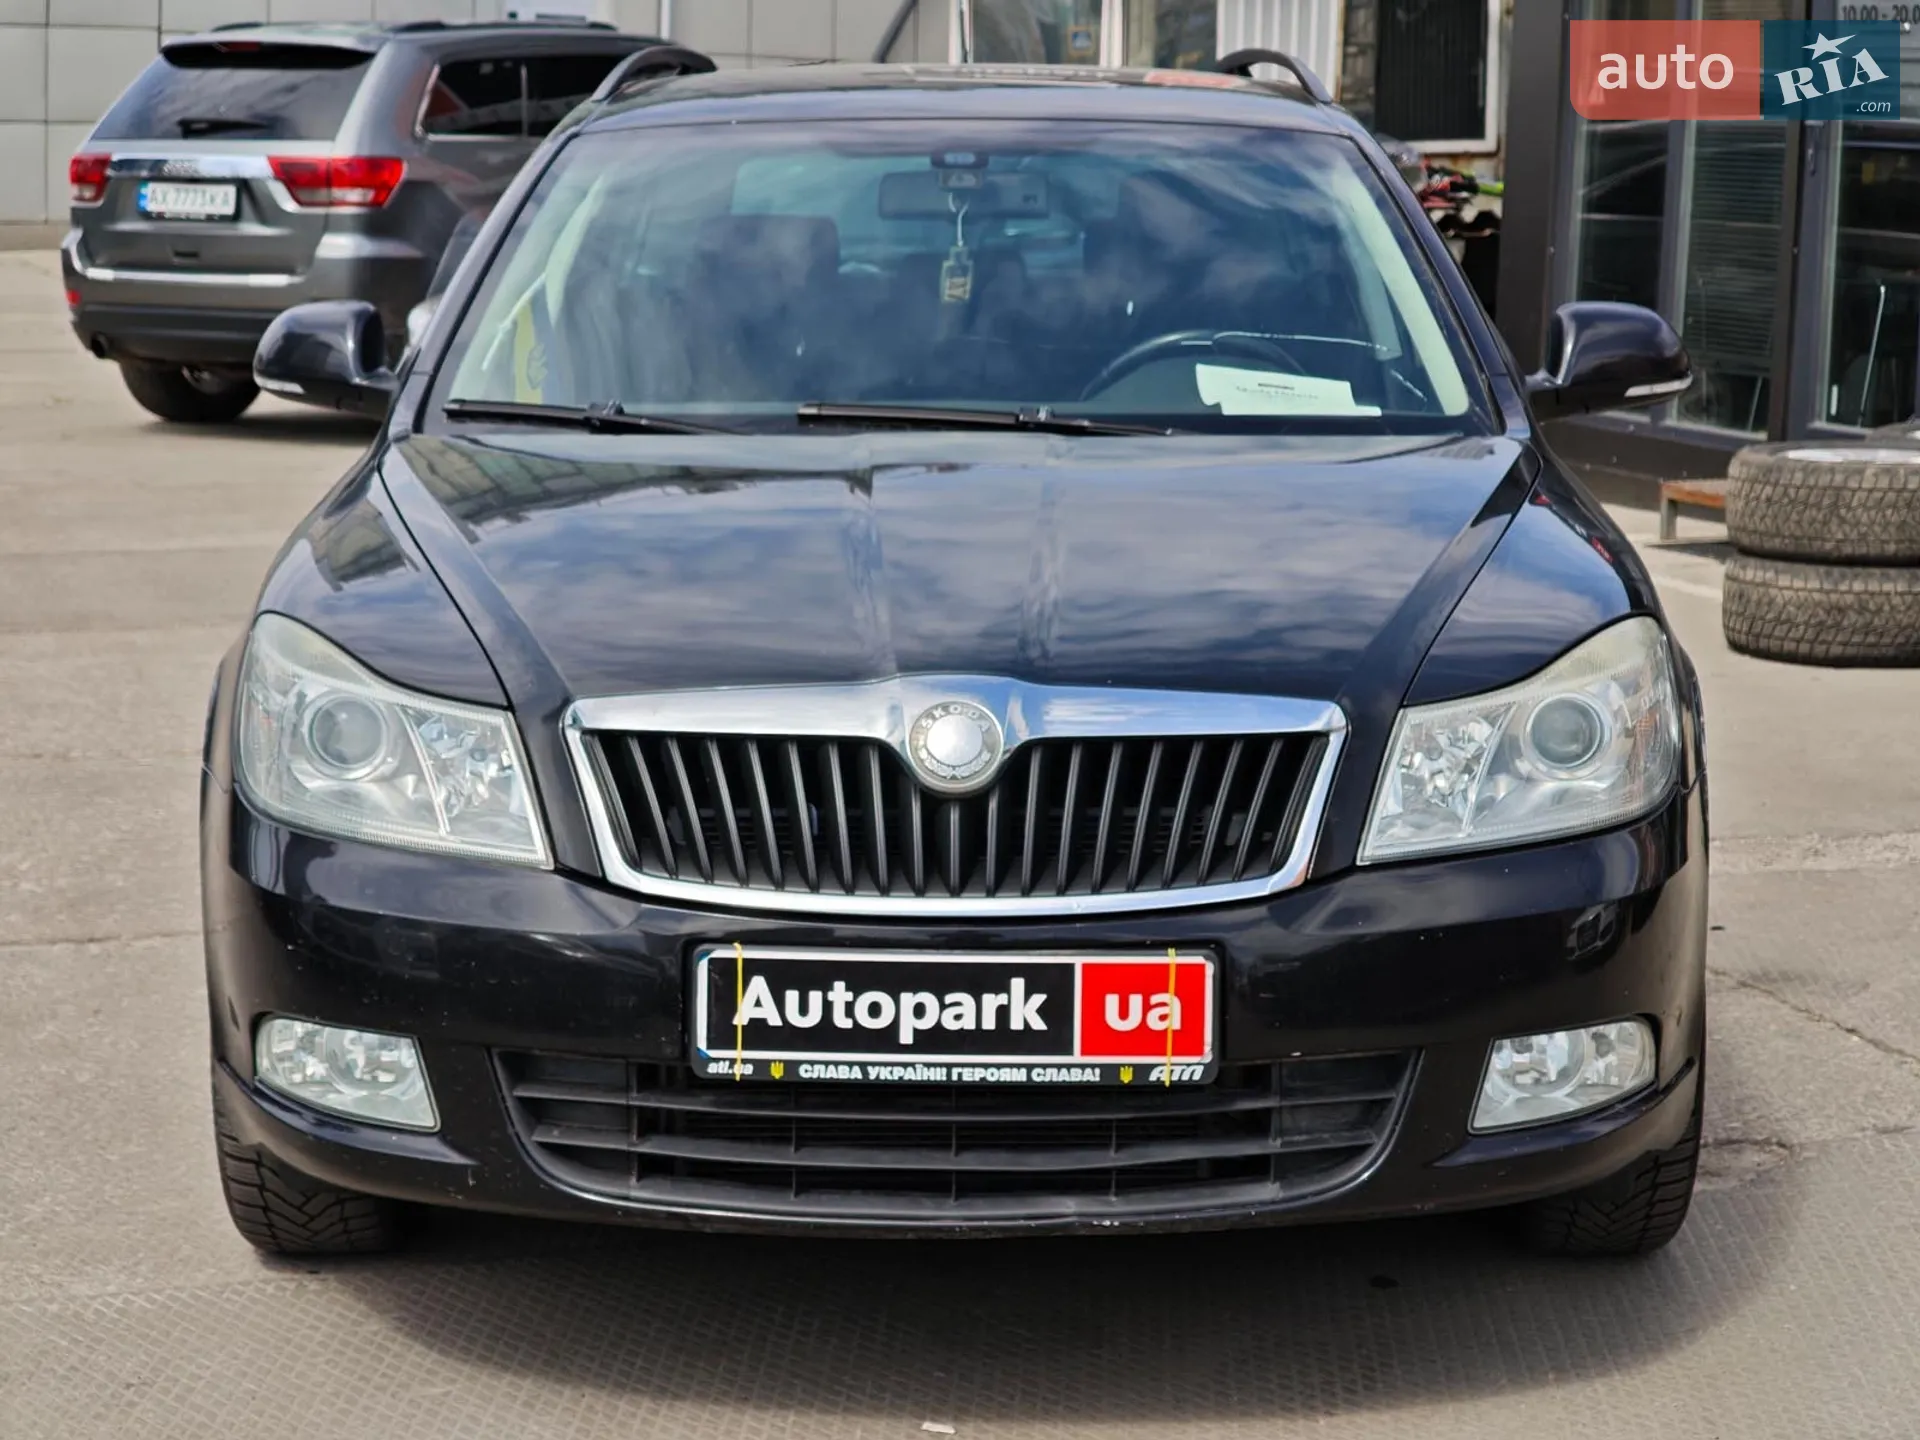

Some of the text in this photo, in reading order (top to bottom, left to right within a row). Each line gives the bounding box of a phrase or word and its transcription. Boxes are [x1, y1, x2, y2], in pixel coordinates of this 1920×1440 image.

[732, 975, 1182, 1045] Autopark ua
[798, 1063, 1101, 1082] СЛАВА УКРАЇНІ! ГЕРОЯМ СЛАВА!
